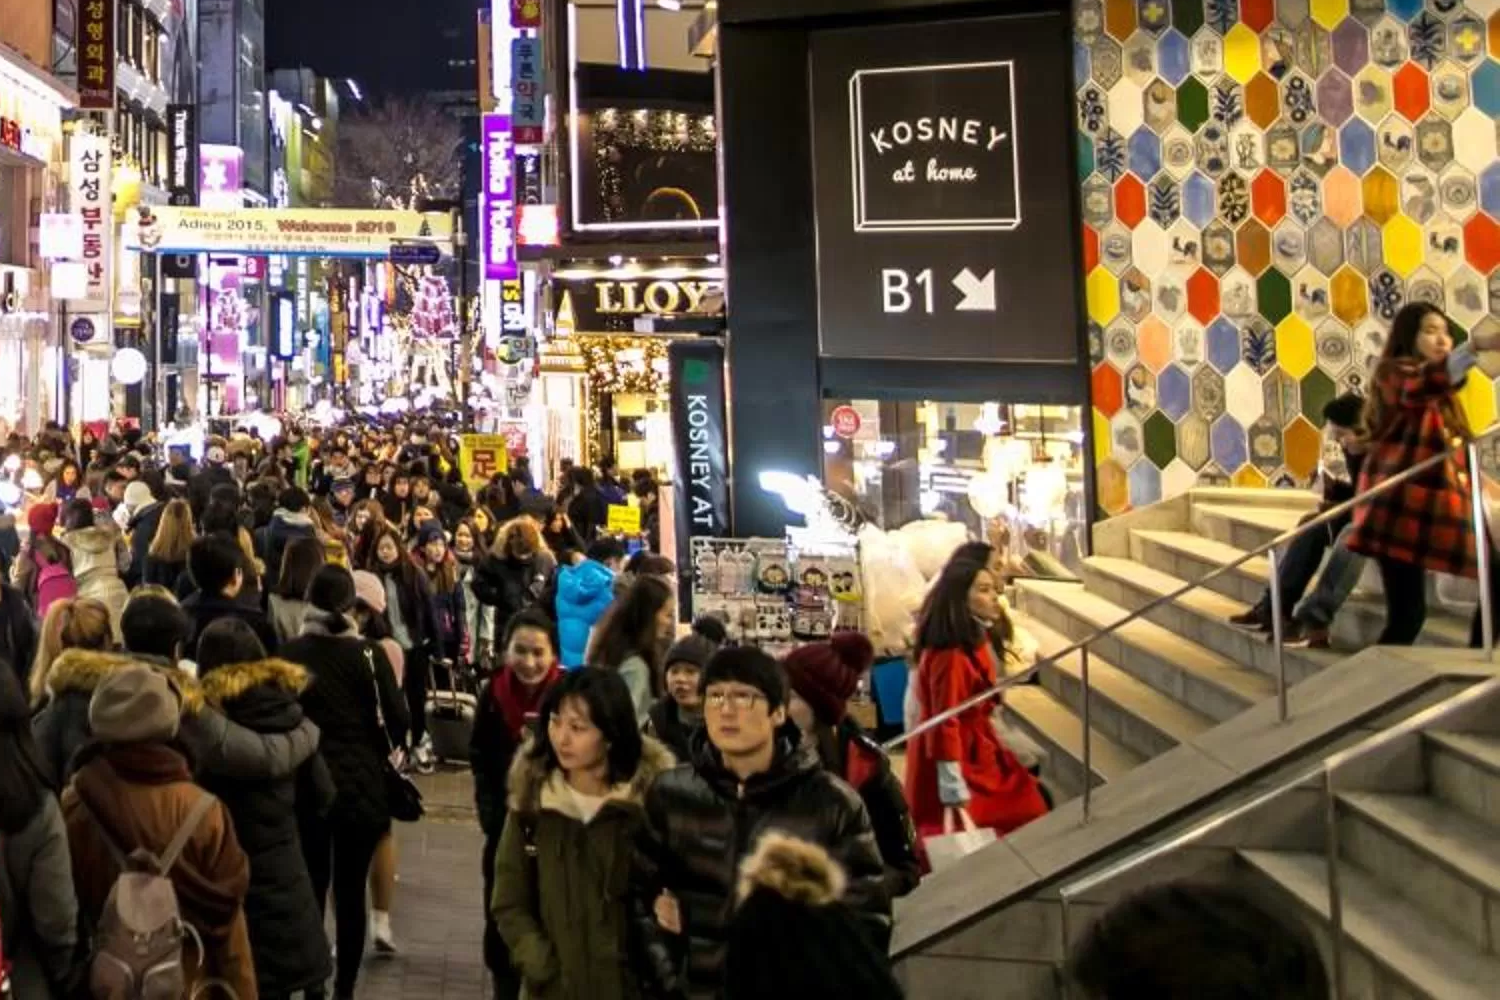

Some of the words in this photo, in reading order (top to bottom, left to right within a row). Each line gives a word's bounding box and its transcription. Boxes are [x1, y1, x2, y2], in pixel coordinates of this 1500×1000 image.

[870, 116, 1008, 154] KOSNEY
[891, 158, 916, 182] at
[925, 157, 978, 182] home
[178, 217, 222, 230] Adieu
[226, 218, 268, 232] 2015,
[276, 218, 353, 233] Welcome
[595, 280, 710, 313] LLOY
[881, 267, 935, 315] B1
[687, 394, 712, 490] KOSNEY
[470, 449, 497, 480] 足
[691, 495, 714, 529] AT
